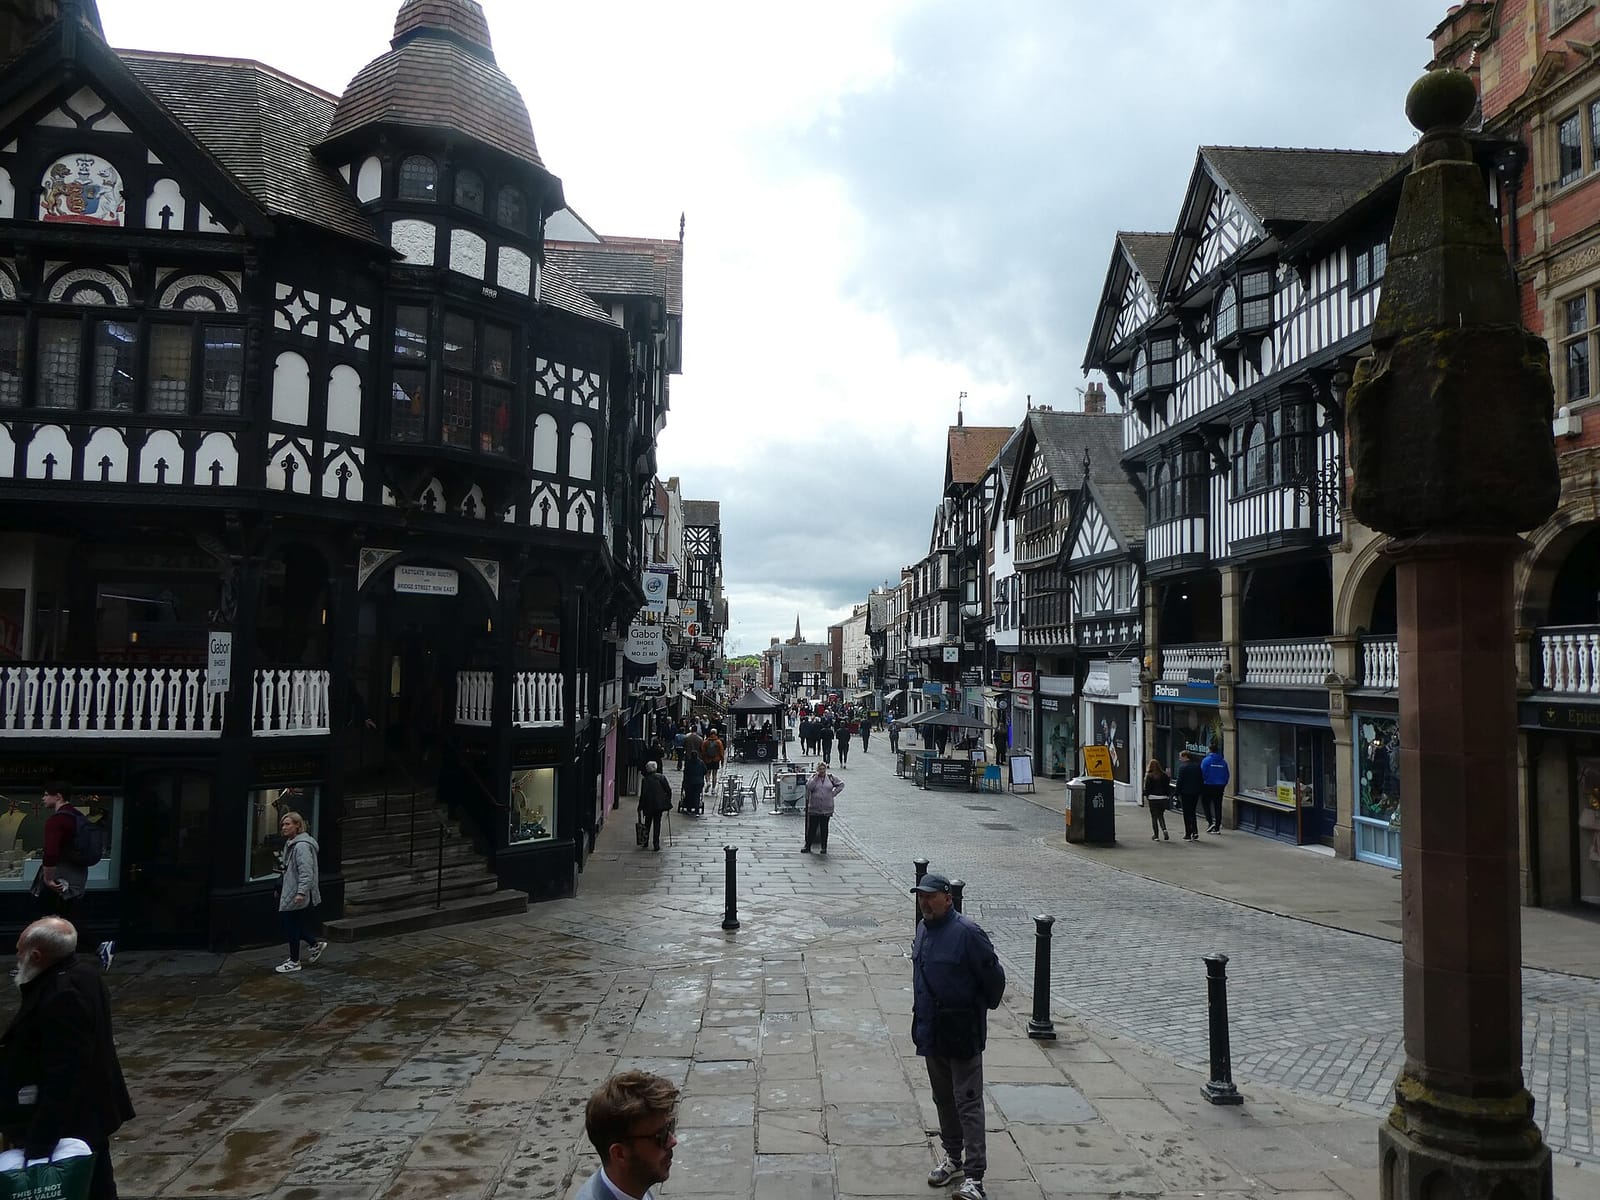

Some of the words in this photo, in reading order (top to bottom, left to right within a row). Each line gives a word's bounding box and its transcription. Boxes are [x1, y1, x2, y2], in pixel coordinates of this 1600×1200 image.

[401, 568, 425, 576] EASTGATE
[630, 628, 660, 639] Gabor
[210, 638, 231, 655] Gabor
[1155, 684, 1179, 697] Rohan
[1185, 741, 1198, 751] Fresh
[11, 1189, 32, 1199] THIS
[34, 1186, 42, 1195] IS
[44, 1183, 62, 1192] NOT
